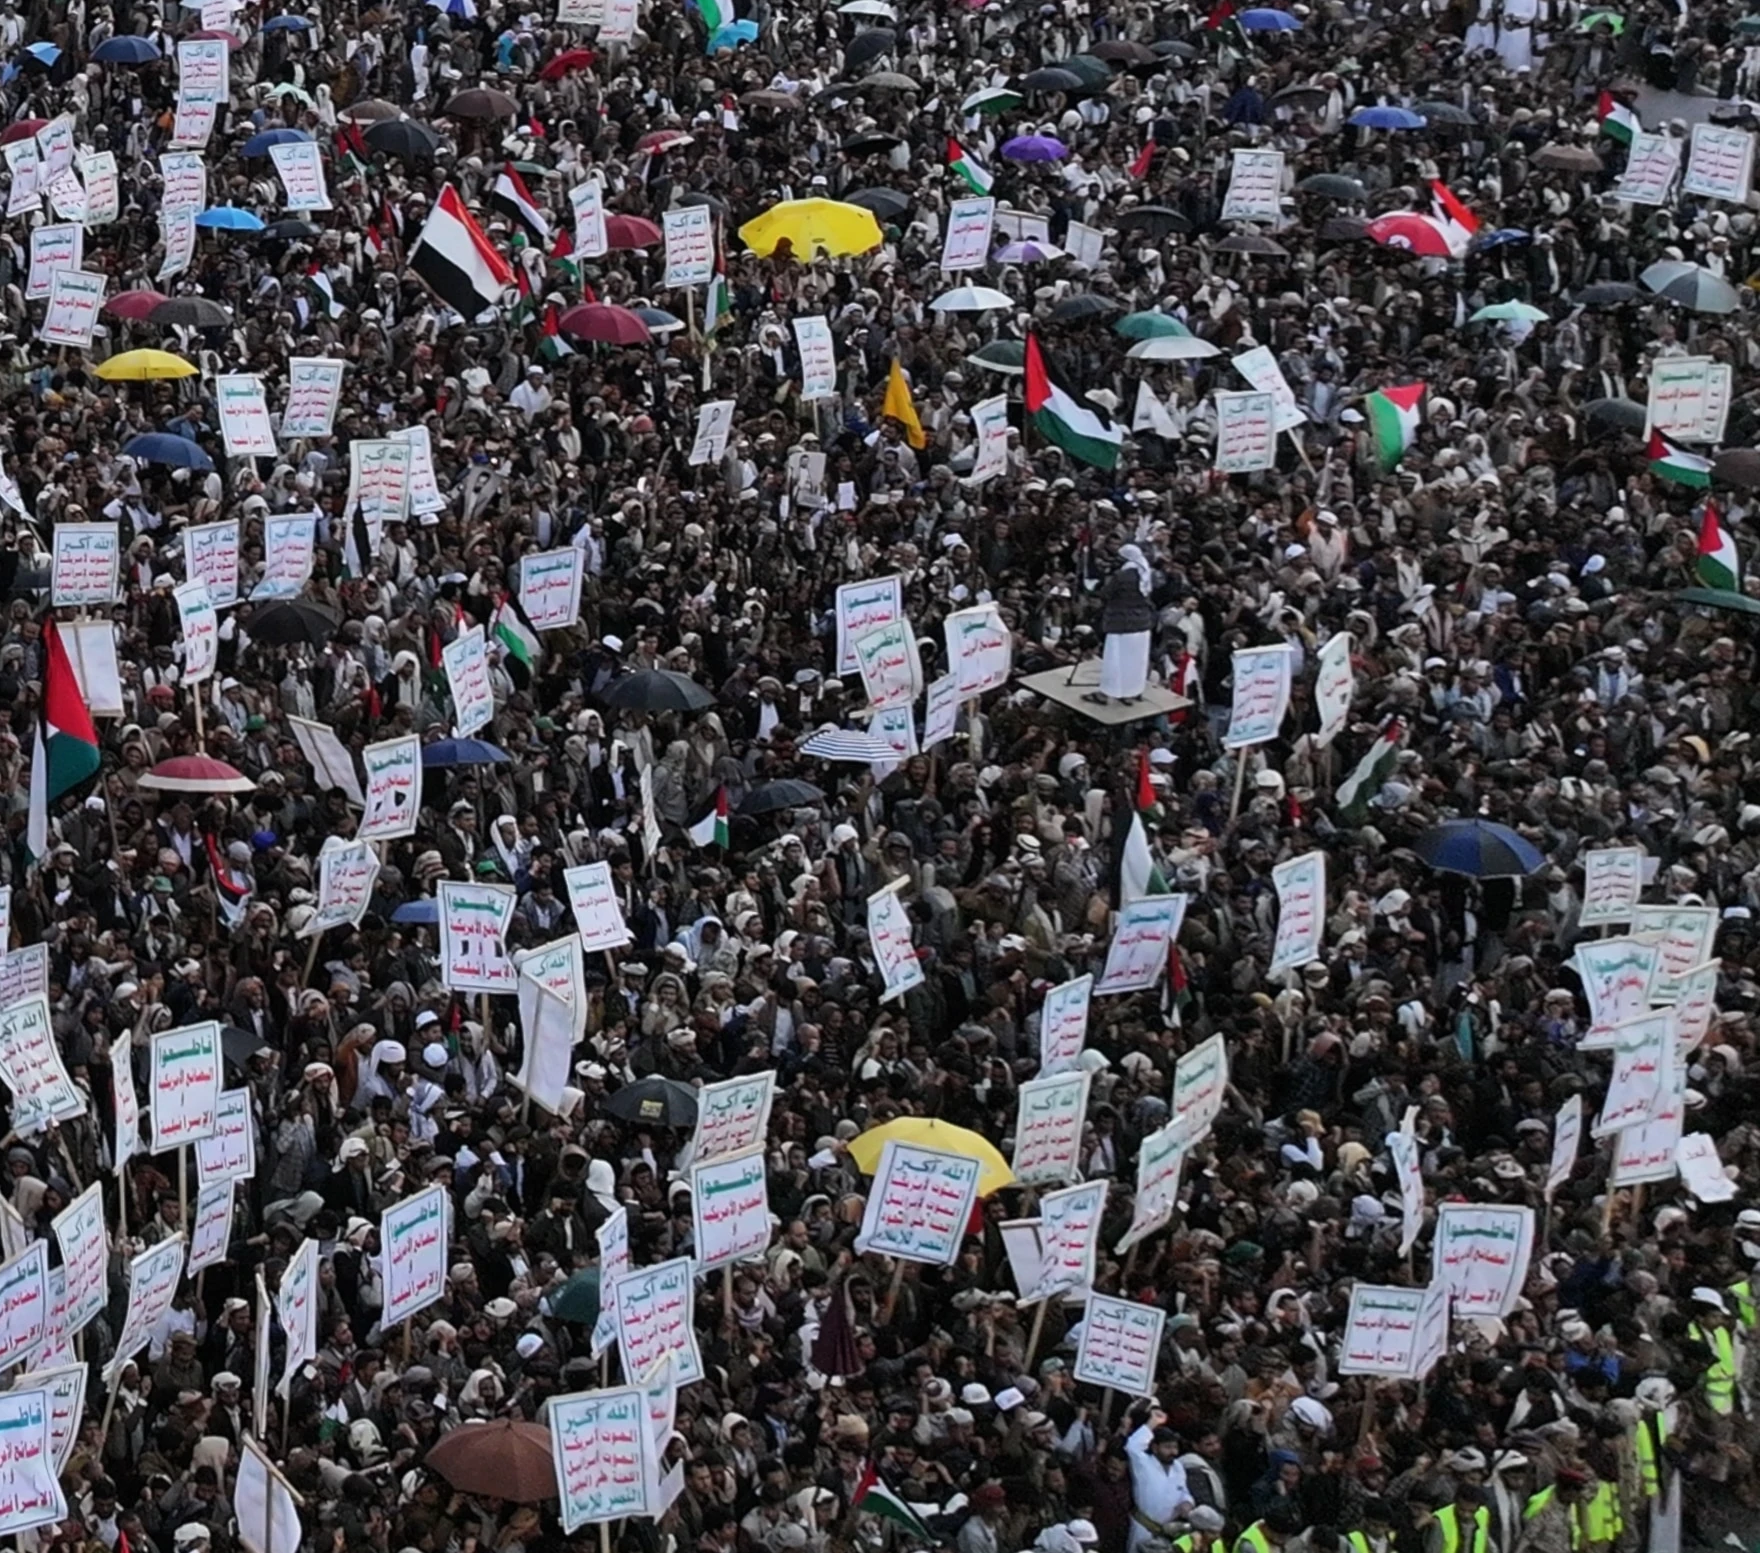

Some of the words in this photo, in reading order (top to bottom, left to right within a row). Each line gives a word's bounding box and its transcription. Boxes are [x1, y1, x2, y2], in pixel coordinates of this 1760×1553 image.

[159, 1036, 212, 1067] قاطعوا
[607, 1402, 637, 1420] الله
[602, 1429, 635, 1444] الموت
[603, 1450, 637, 1466] الموت
